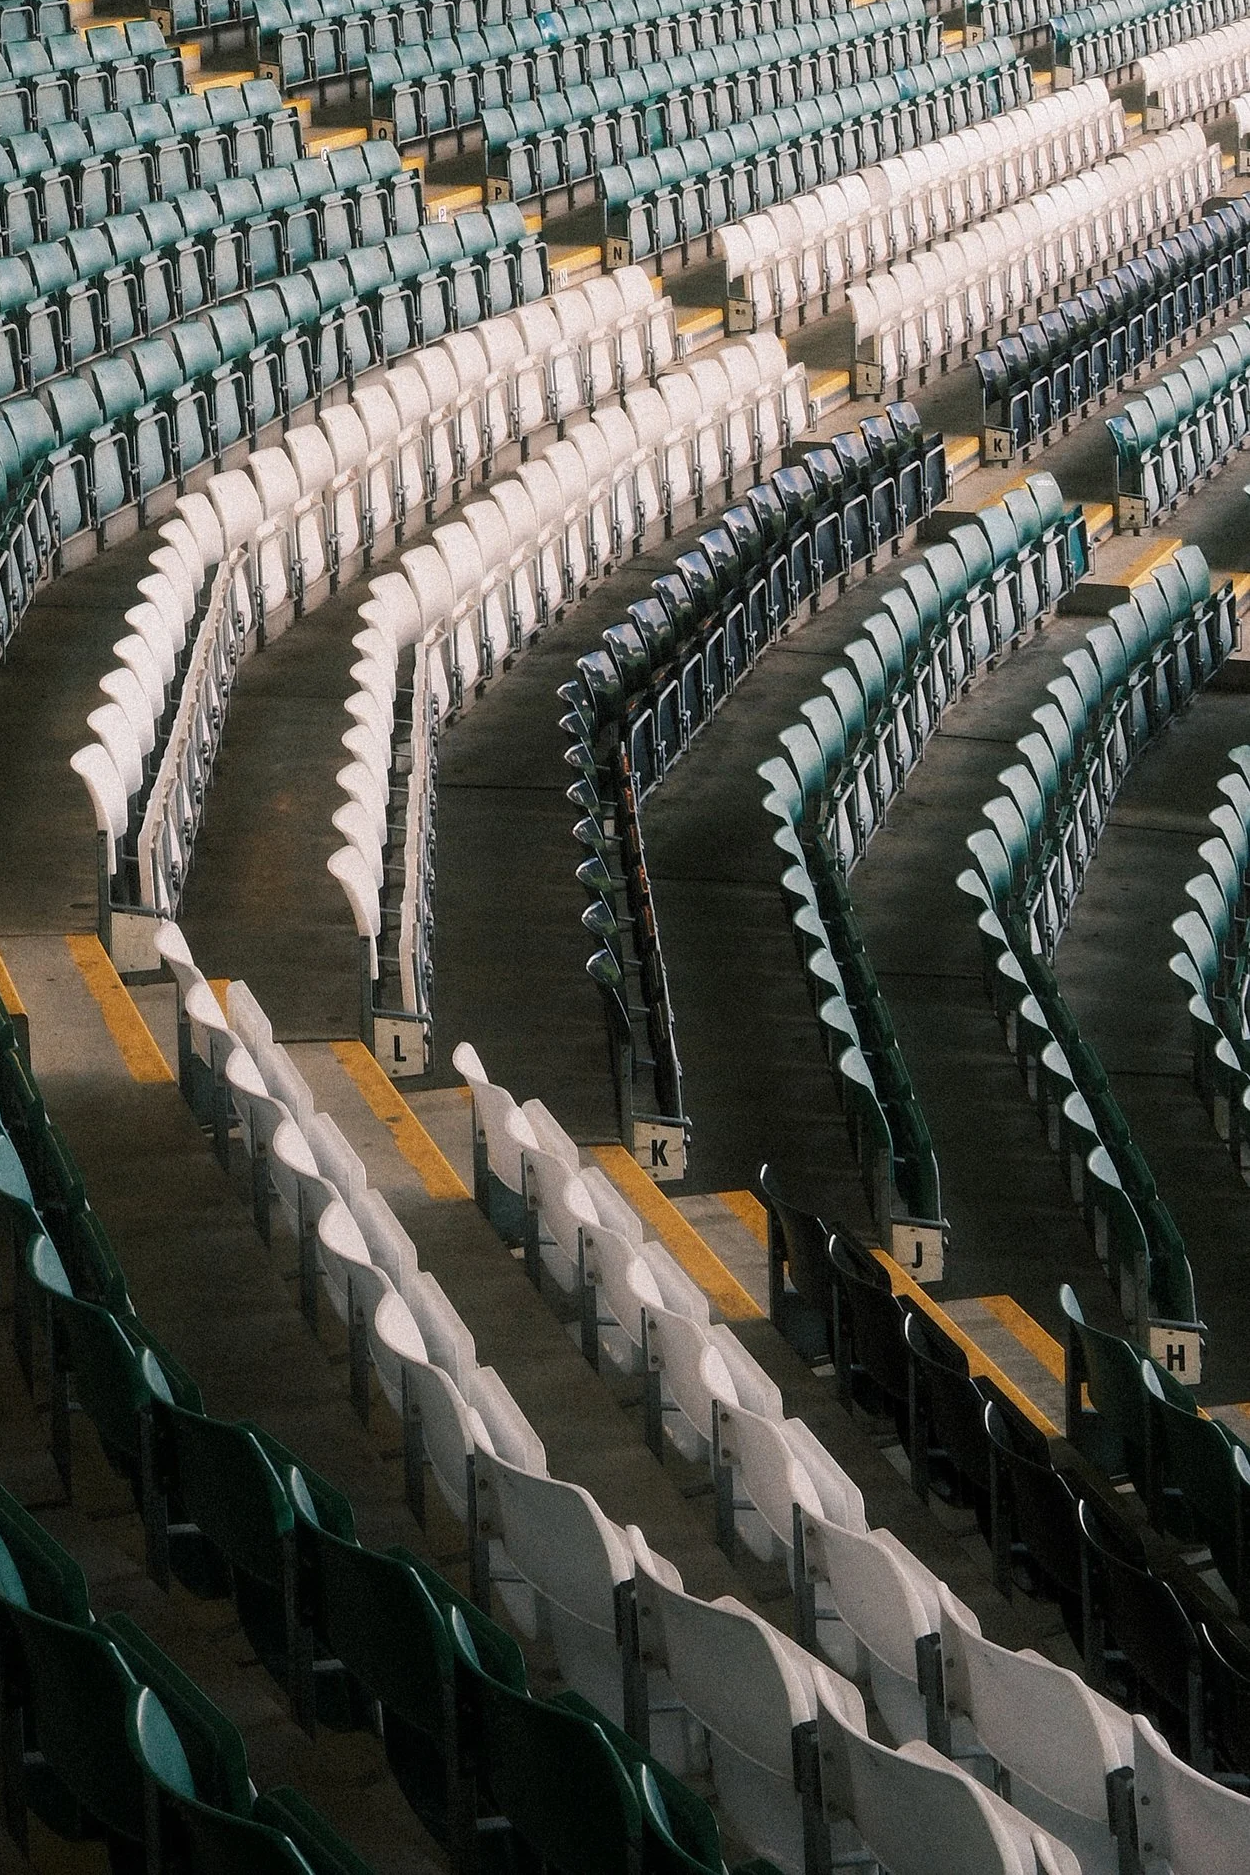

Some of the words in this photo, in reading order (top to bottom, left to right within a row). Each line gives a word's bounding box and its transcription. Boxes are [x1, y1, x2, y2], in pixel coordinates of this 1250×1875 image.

[495, 187, 502, 200] P
[613, 246, 622, 260] N
[994, 438, 1003, 452] K
[393, 1035, 407, 1062] L
[651, 1139, 670, 1166] K
[911, 1241, 923, 1269] J
[1166, 1344, 1186, 1372] H
